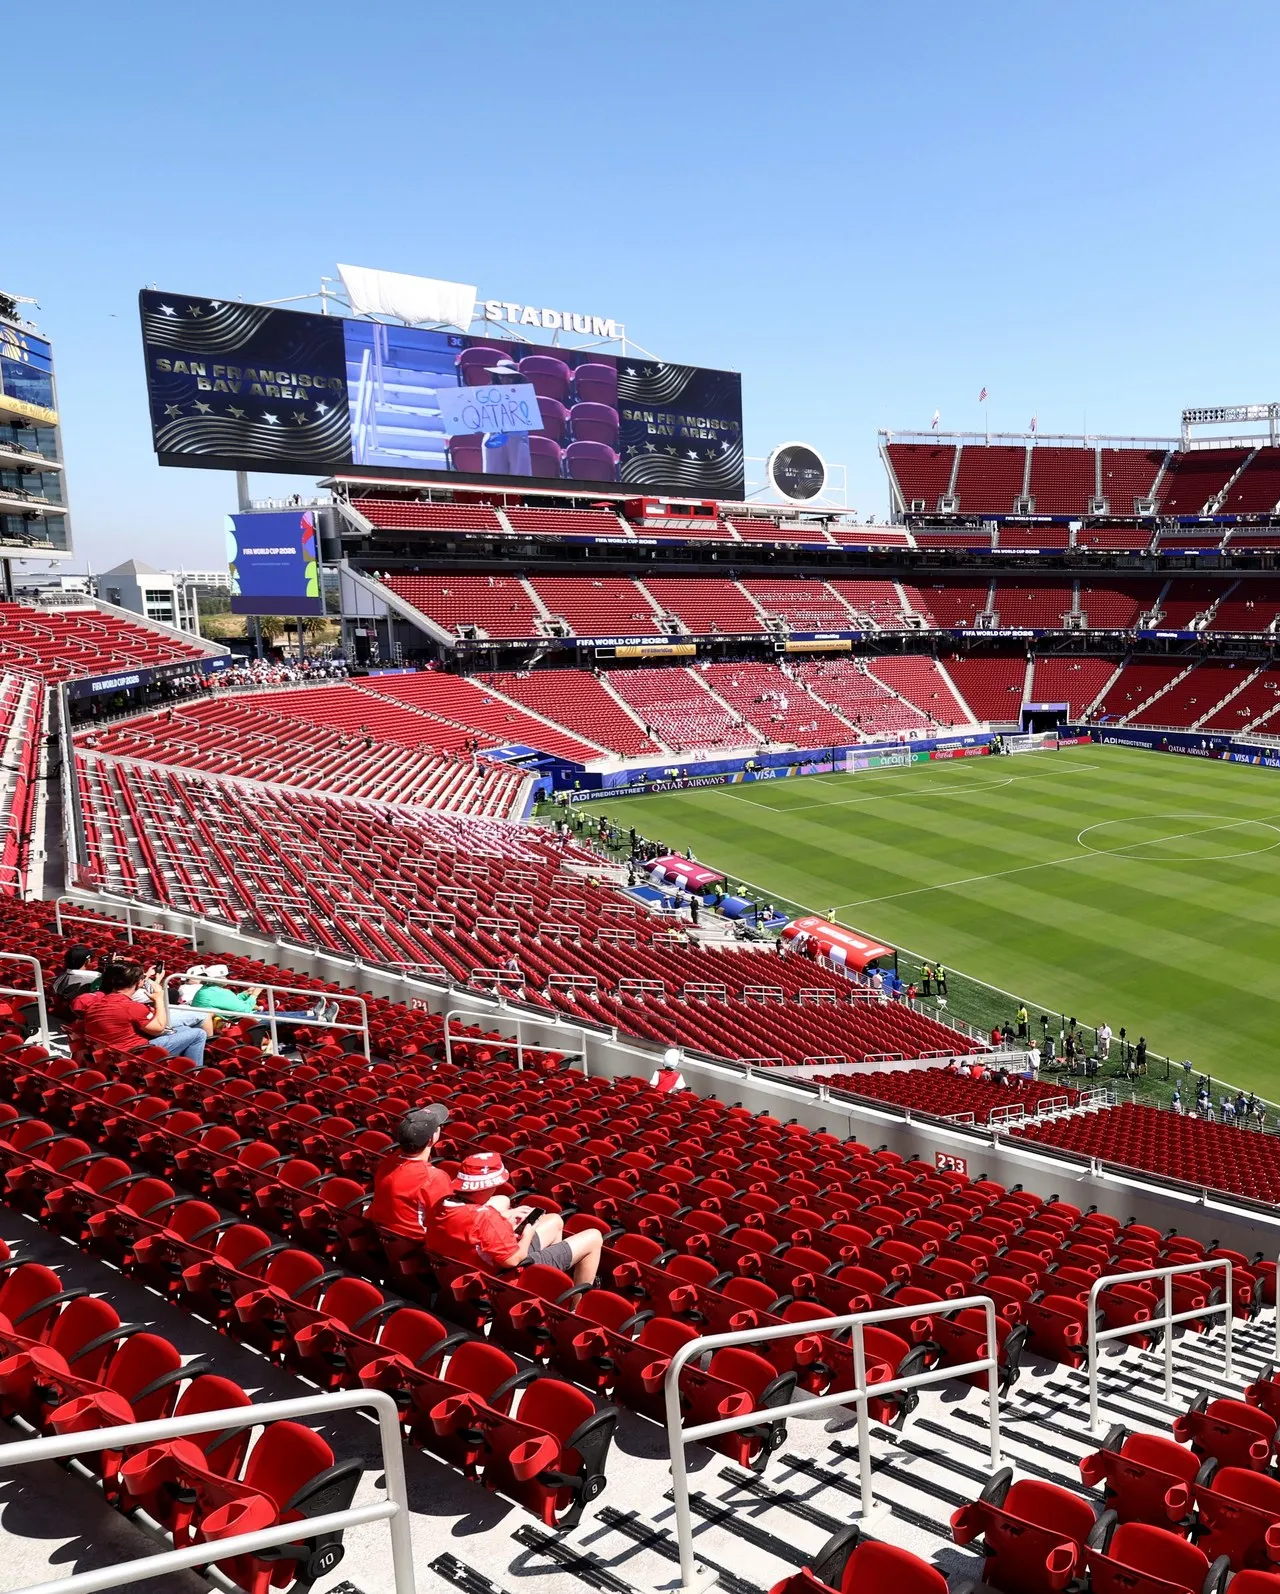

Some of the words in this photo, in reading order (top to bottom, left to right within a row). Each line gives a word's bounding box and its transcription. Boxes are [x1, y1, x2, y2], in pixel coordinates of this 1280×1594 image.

[484, 299, 615, 338] STADIUM
[156, 359, 206, 376] SAN
[213, 364, 344, 390] FRANCISCO
[198, 376, 242, 394] BAY
[249, 383, 309, 401] AREA
[475, 389, 501, 404] GO
[462, 401, 532, 429] QATAR!
[623, 409, 653, 423] SAN
[657, 413, 739, 431] FRANCISCO
[648, 423, 676, 436] BAY
[680, 427, 717, 440] AREA
[92, 682, 102, 691] FIFA
[102, 679, 118, 689] WORLD
[126, 675, 140, 685] 2026
[1118, 739, 1153, 748] PREDICTSTREET
[1168, 745, 1185, 754] QATAR
[1187, 748, 1209, 757] AIRWAYS
[1234, 753, 1249, 763] VISA
[1264, 758, 1280, 767] VISA
[754, 769, 776, 780] VISA
[652, 781, 683, 793] QATAR
[687, 777, 725, 788] AIRWAYS
[572, 793, 590, 803] ADI
[591, 787, 645, 799] PREDICTSTREET
[938, 1154, 964, 1174] 233
[591, 1484, 598, 1494] 9
[320, 1553, 334, 1569] 10
